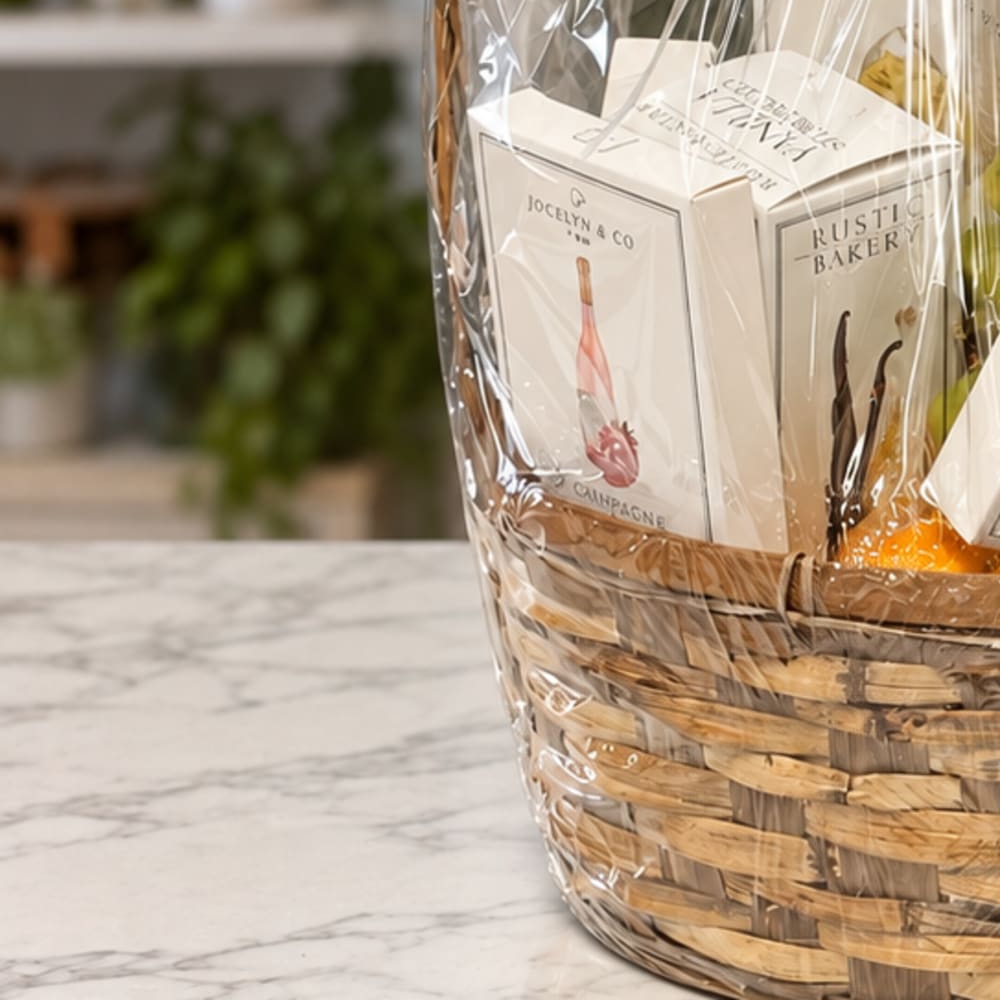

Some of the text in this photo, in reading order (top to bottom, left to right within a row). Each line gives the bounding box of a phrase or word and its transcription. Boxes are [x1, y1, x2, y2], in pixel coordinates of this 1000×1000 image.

[528, 194, 591, 232] JOCELYN
[612, 229, 635, 251] CO
[812, 194, 925, 249] RUSTIC
[813, 222, 921, 275] BAKERY
